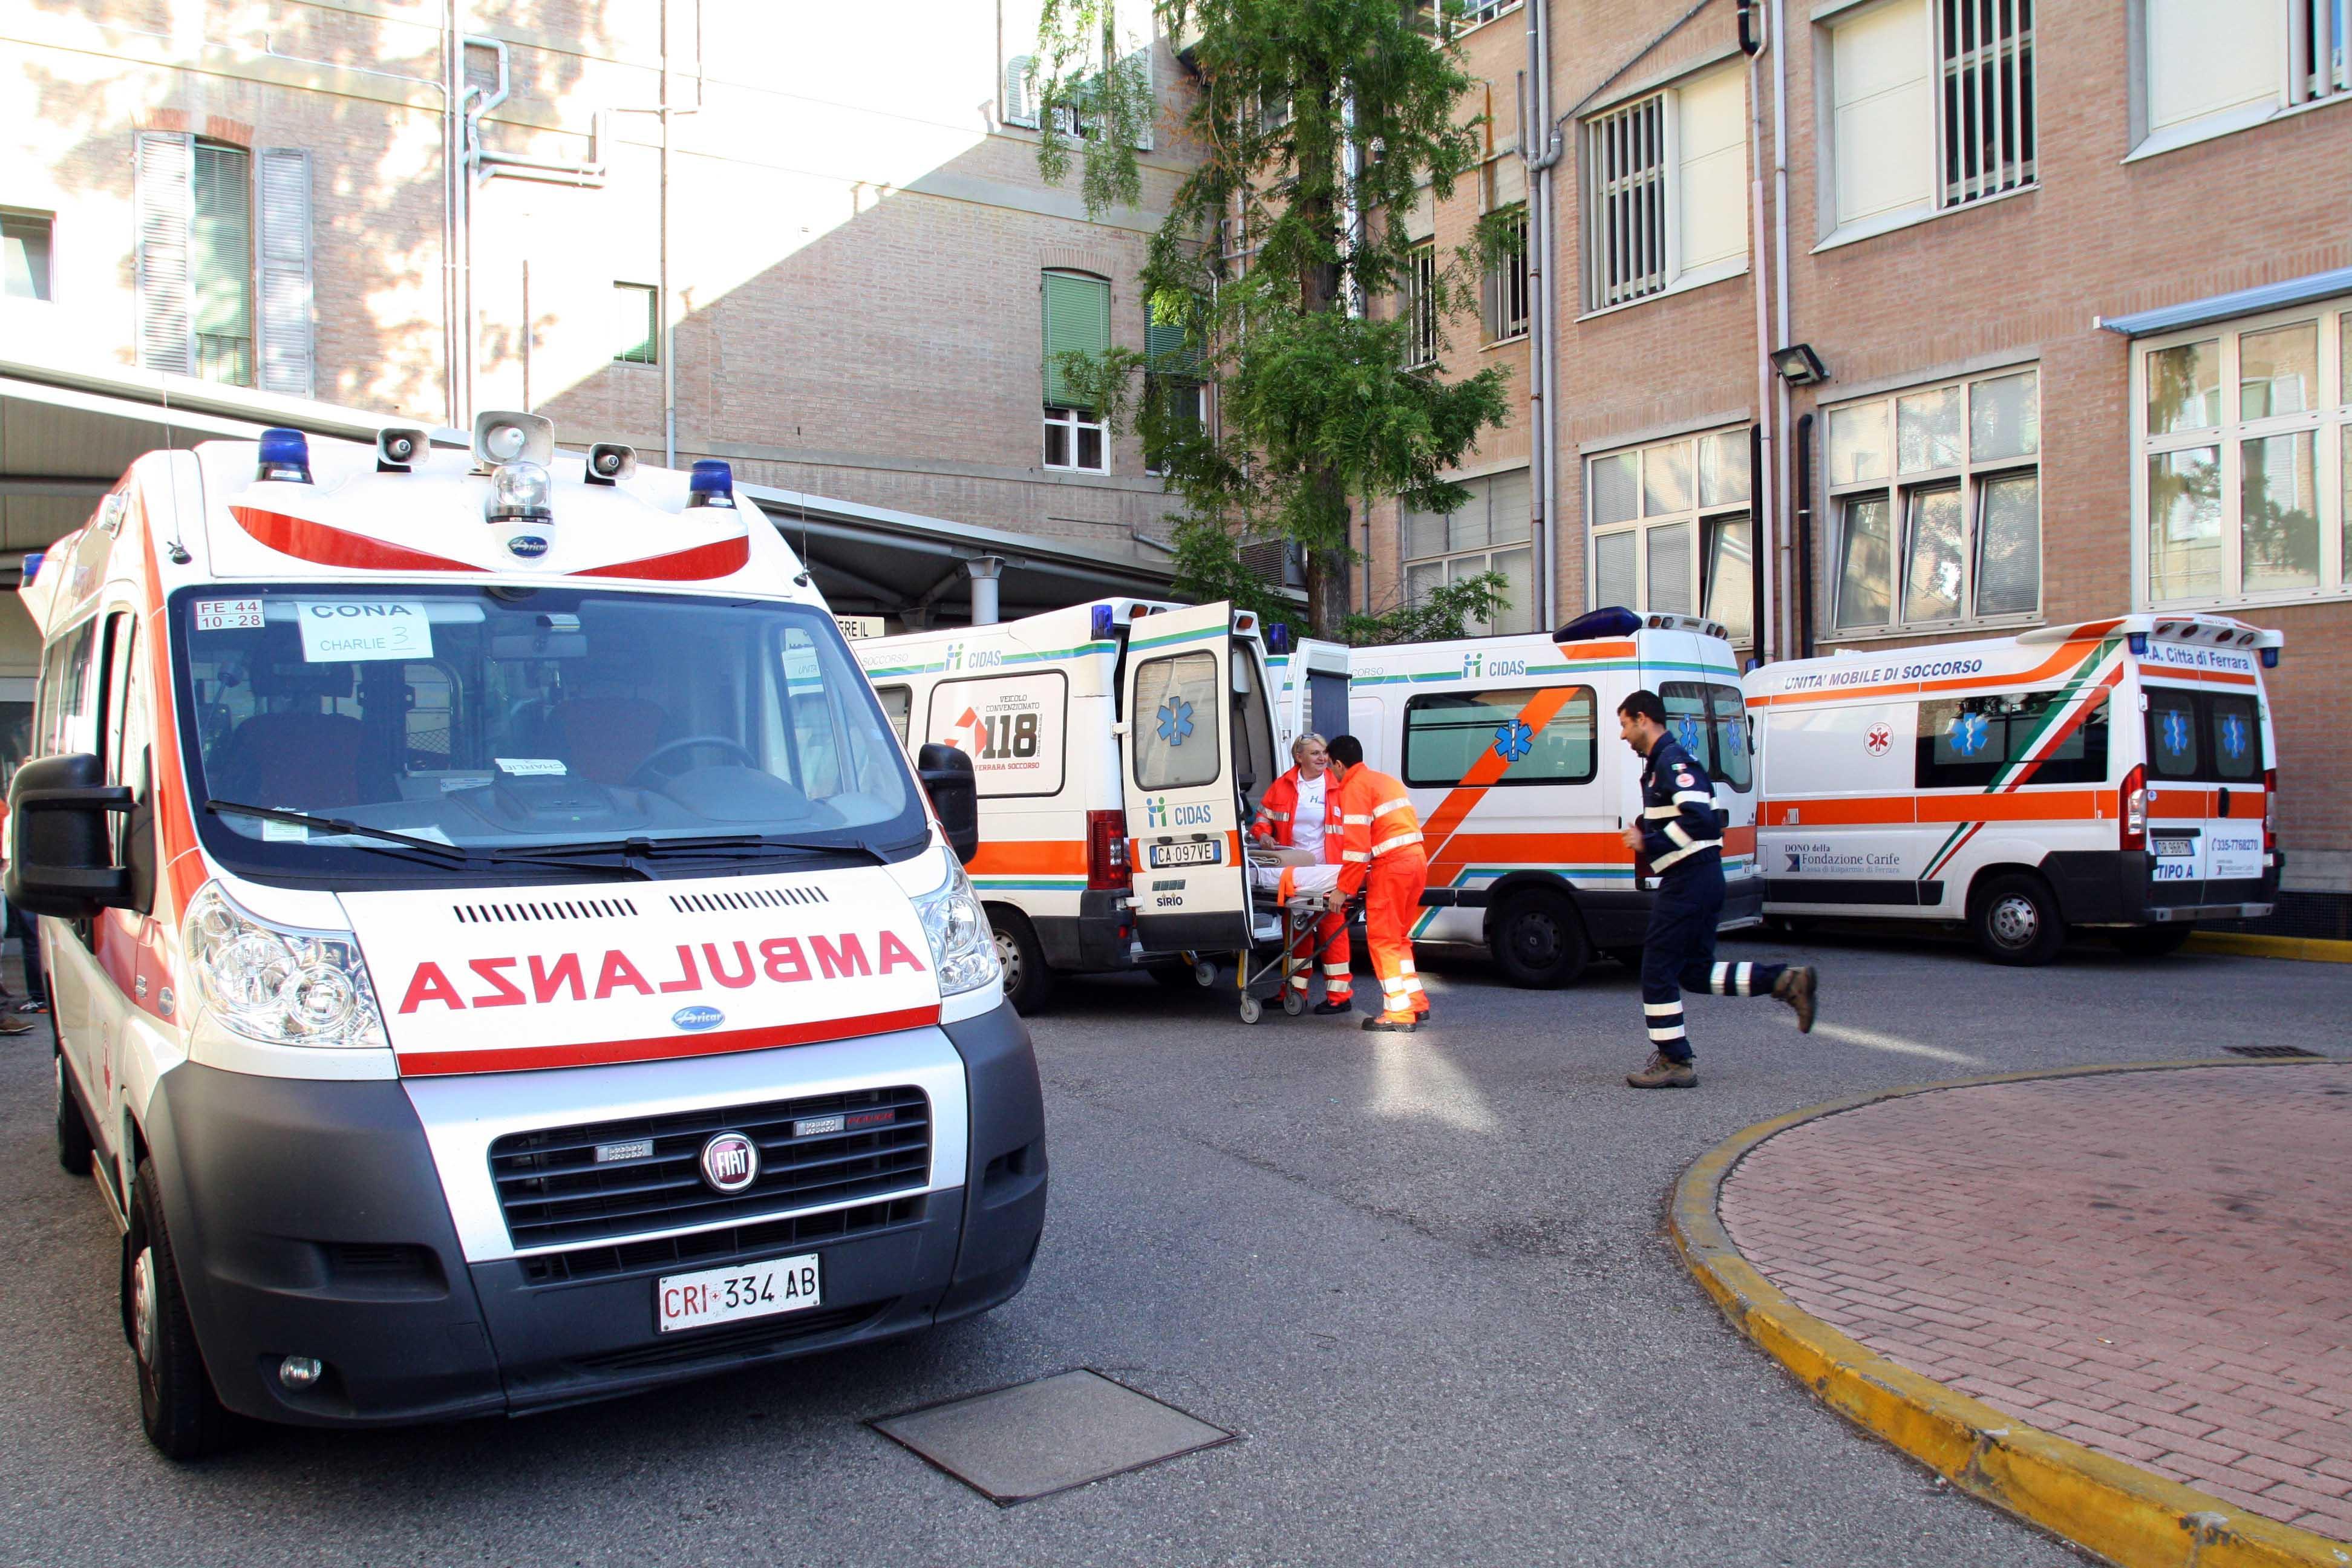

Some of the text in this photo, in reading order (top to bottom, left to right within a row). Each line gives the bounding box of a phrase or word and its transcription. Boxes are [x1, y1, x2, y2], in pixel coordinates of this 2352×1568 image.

[201, 601, 258, 613] FE 44
[310, 605, 413, 619] CONA
[837, 620, 869, 637] ERE IL
[320, 626, 409, 652] CHARLIE 3
[863, 653, 909, 666] SOCCORSO
[969, 650, 1002, 668] CIDAS
[2197, 650, 2207, 665] di
[2209, 652, 2249, 669] Ferrara
[1351, 667, 1384, 677] CORSO
[1489, 659, 1524, 677] CIDAS
[1829, 669, 1881, 686] MOBILE
[1883, 667, 1898, 681] DI
[1902, 659, 1982, 679] SOCCORSO
[1000, 694, 1027, 703] VEICOLO
[985, 702, 1040, 712] CONVENZIONATO
[982, 713, 1037, 759] 118
[1174, 805, 1212, 825] CIDAS
[1812, 844, 1830, 852] della
[1802, 853, 1900, 864] Fondazione Carife
[2157, 864, 2194, 878] TIPO A
[1156, 896, 1183, 907] SIRIO
[716, 1149, 746, 1177] FIAT
[664, 1267, 816, 1318] CRI 334 AB
